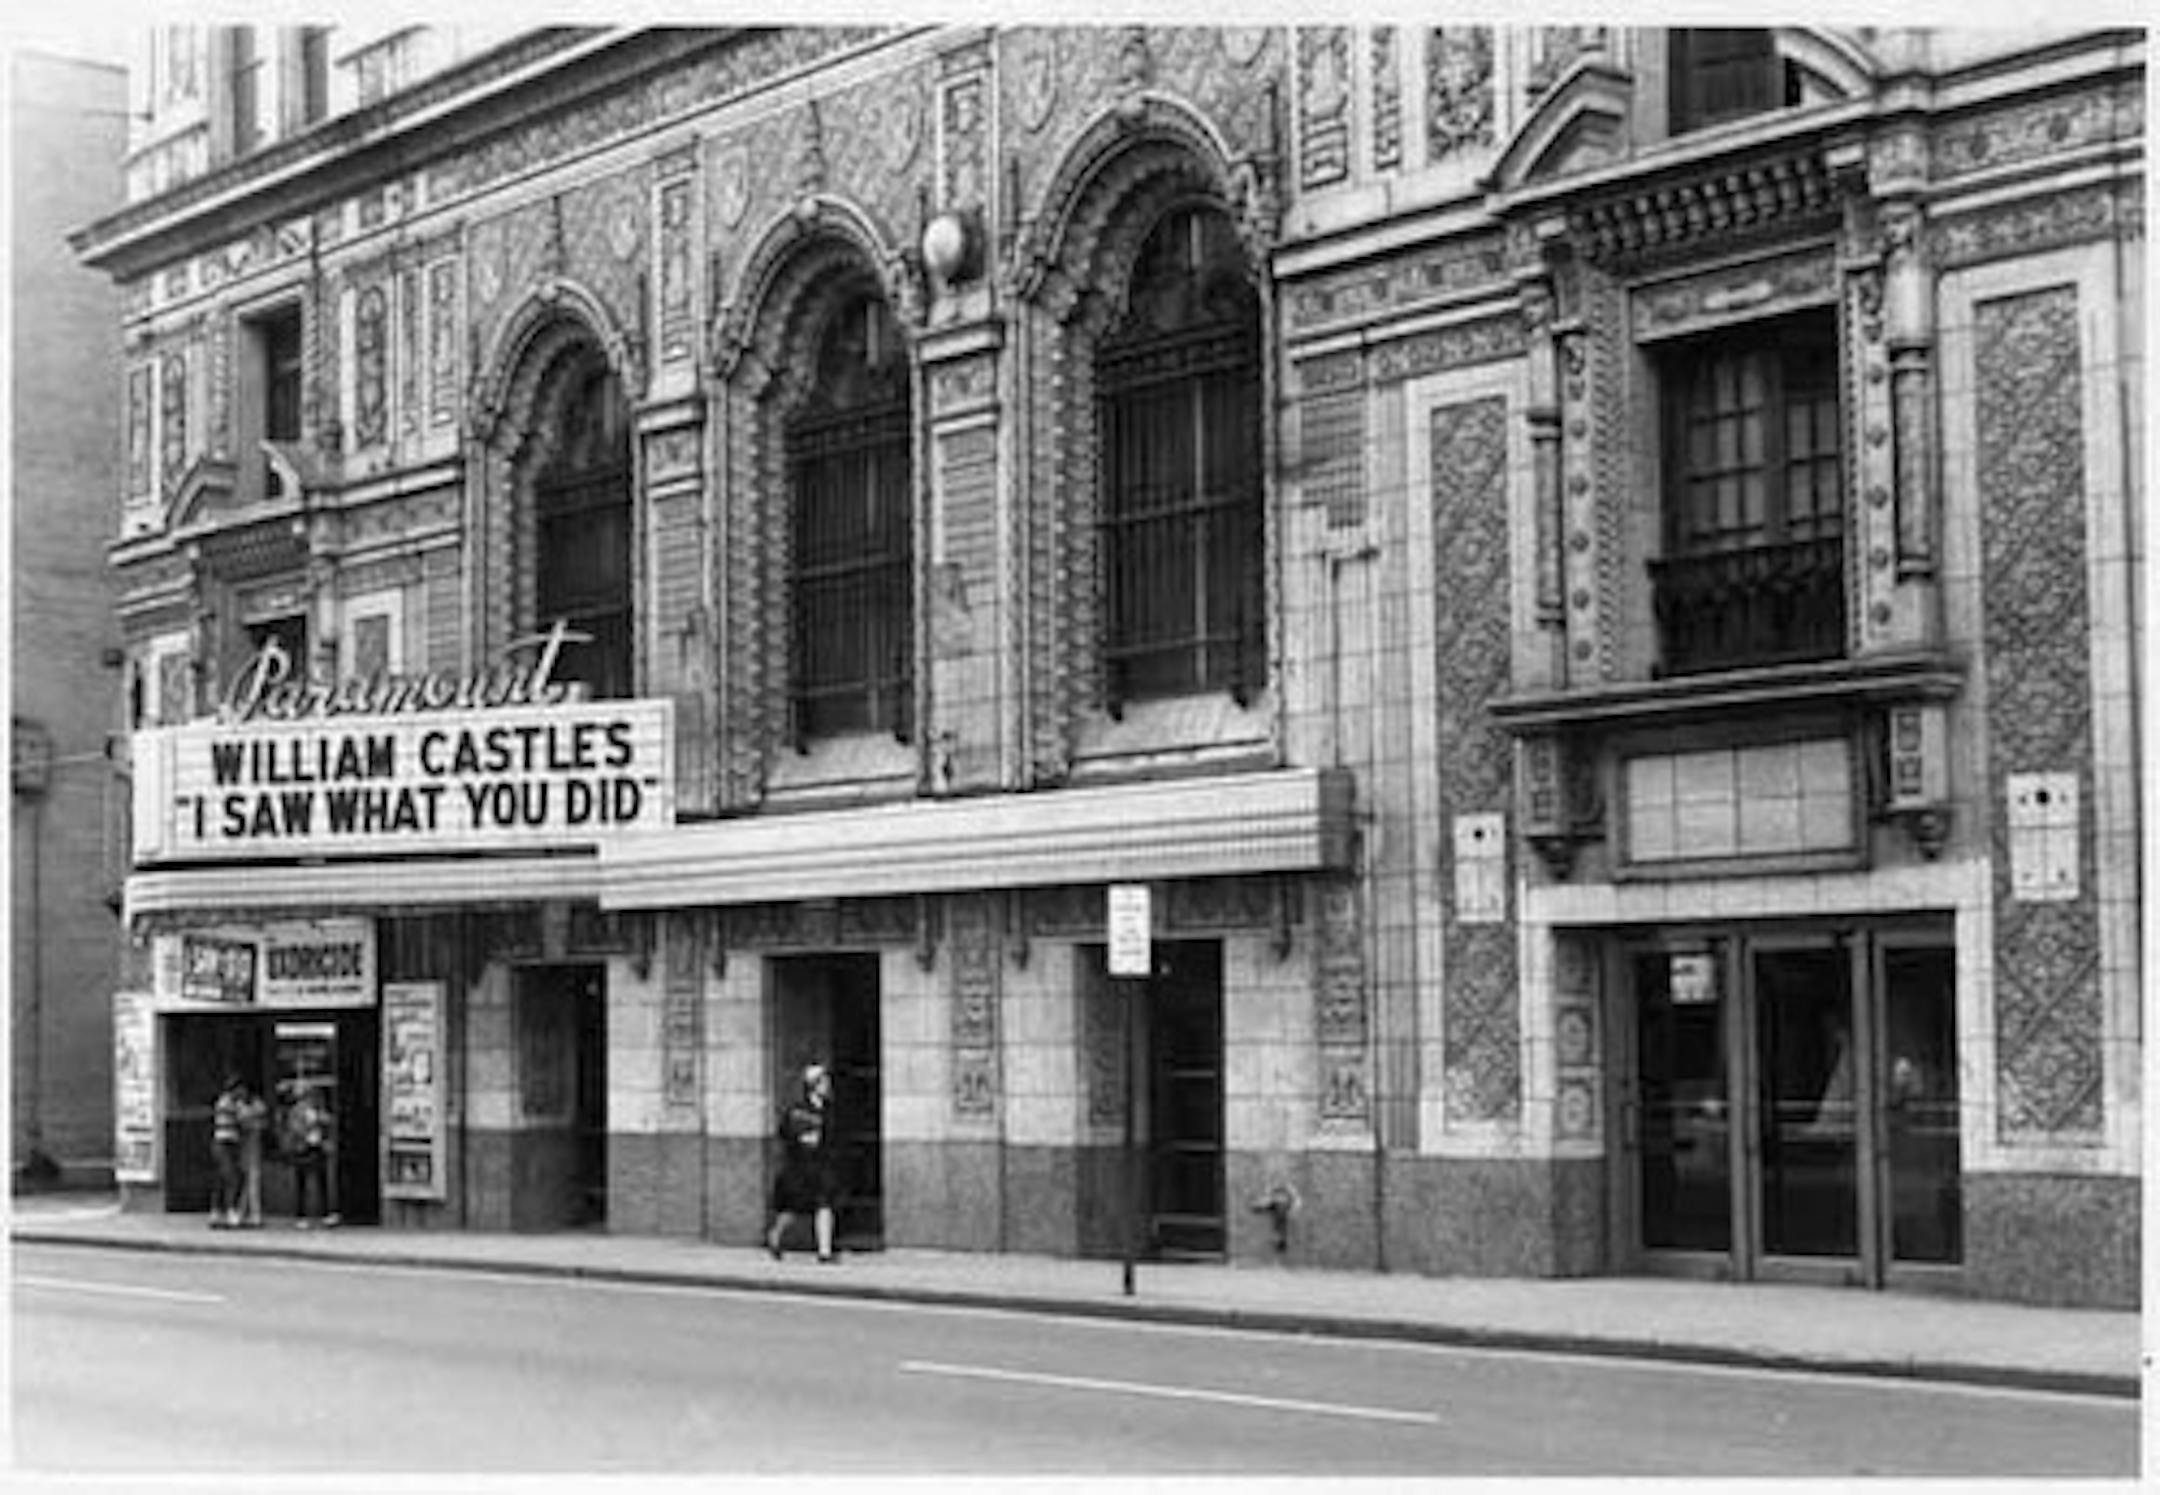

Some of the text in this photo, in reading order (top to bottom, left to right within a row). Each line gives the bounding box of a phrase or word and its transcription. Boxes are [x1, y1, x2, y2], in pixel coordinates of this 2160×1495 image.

[218, 617, 594, 724] Paramount
[212, 734, 396, 786] WILLIAM
[223, 791, 315, 838] SAW
[325, 786, 447, 834] WHAT
[464, 781, 550, 829] YOU
